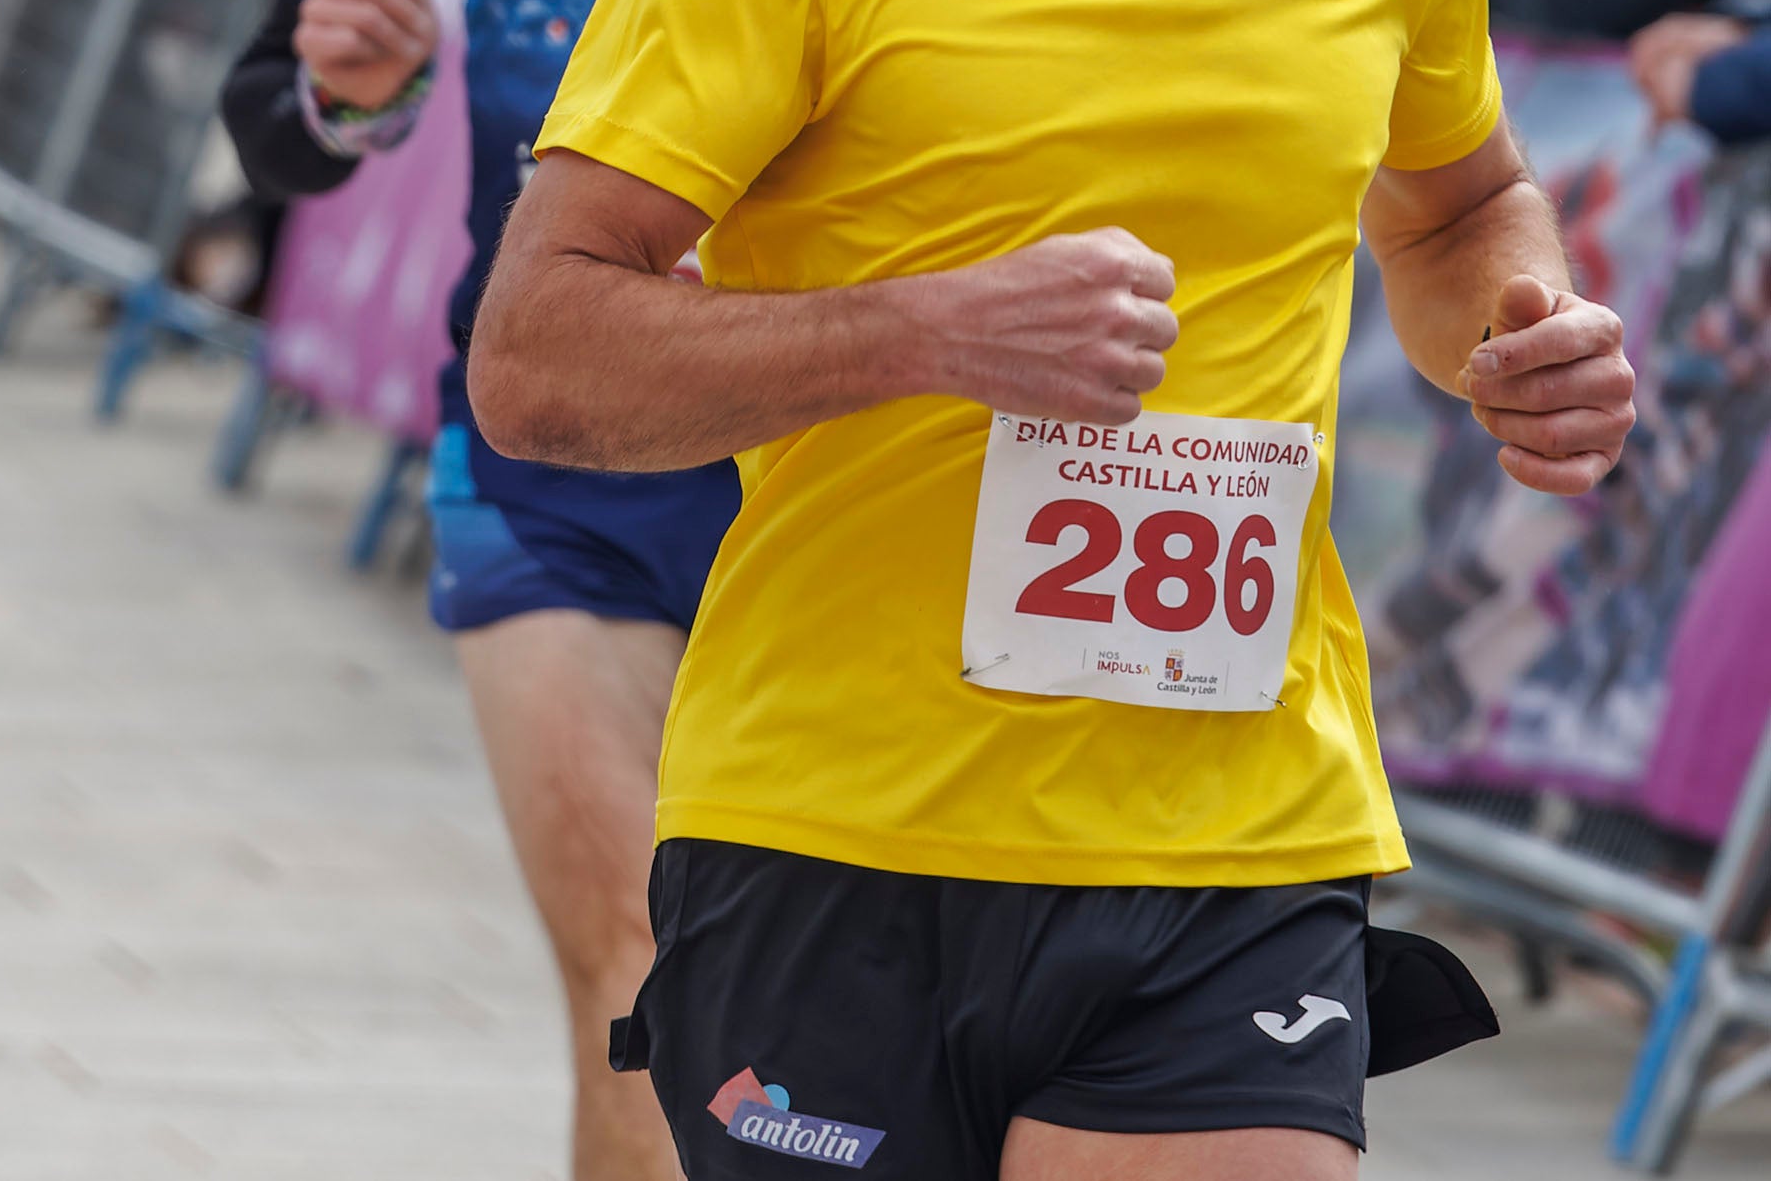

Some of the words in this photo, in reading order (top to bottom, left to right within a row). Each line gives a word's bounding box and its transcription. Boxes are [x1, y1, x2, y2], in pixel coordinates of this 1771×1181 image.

[1016, 419, 1068, 446] DÍA
[1077, 425, 1119, 451] DE
[1127, 431, 1163, 456] LA
[1172, 437, 1309, 466] COMUNIDAD
[1058, 459, 1198, 494] CASTILLA
[1206, 474, 1222, 497] Y
[1226, 470, 1270, 498] LEÓN
[1015, 498, 1277, 636] 286
[1098, 651, 1120, 660] NOS
[1157, 682, 1190, 694] Castilla
[1191, 687, 1197, 696] y
[1198, 685, 1217, 695] León
[1184, 674, 1207, 684] Junta
[1208, 676, 1218, 684] de
[740, 1113, 860, 1163] antolin
